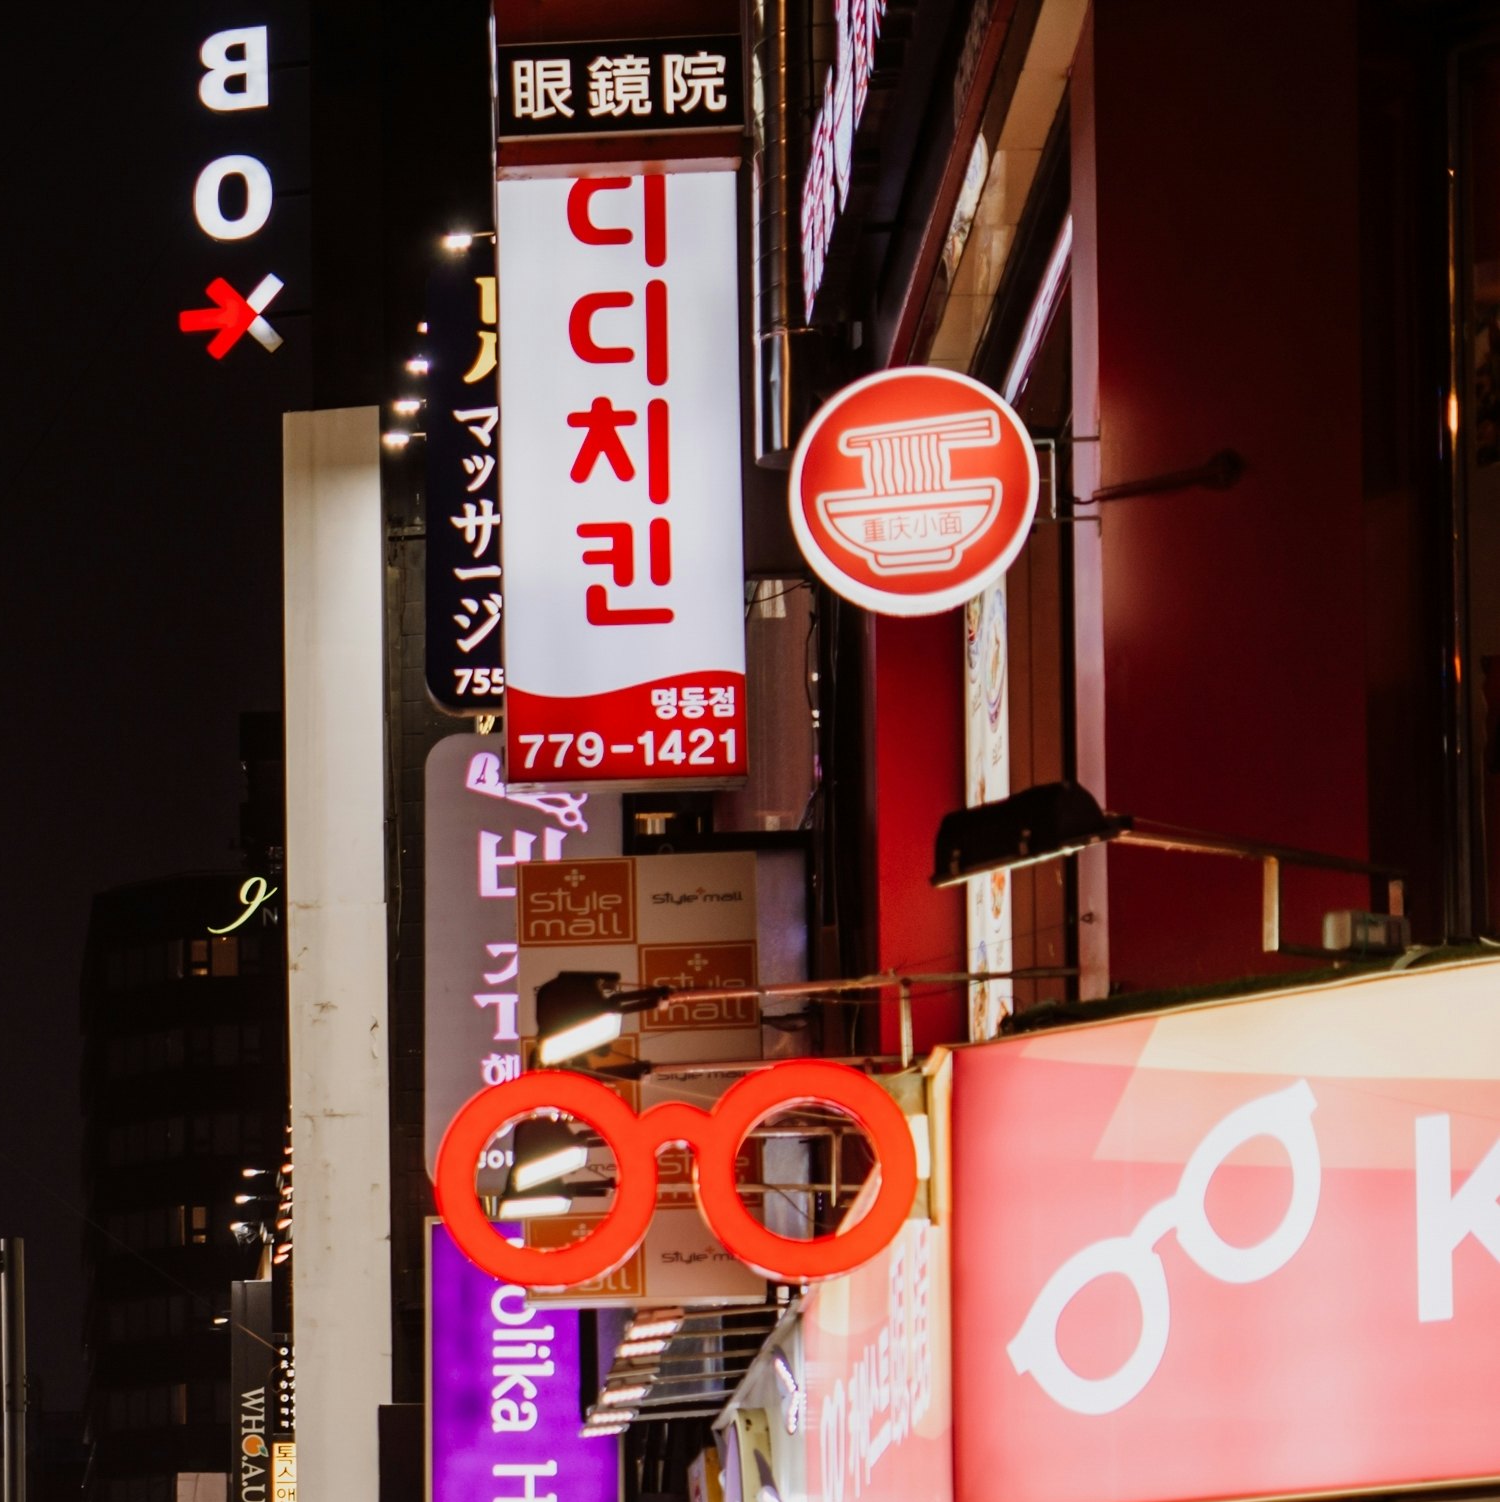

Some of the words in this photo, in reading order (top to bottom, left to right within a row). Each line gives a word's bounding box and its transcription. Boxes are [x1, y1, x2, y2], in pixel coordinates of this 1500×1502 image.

[512, 52, 728, 120] 眼鏡院
[565, 174, 675, 628] 디디치킨
[451, 405, 500, 653] マッサージ
[862, 510, 964, 543] 重庆小面
[650, 686, 735, 720] 명동점
[518, 729, 737, 770] 779-1421
[529, 887, 623, 917] Style
[529, 913, 623, 937] mall
[491, 1285, 555, 1434] olika
